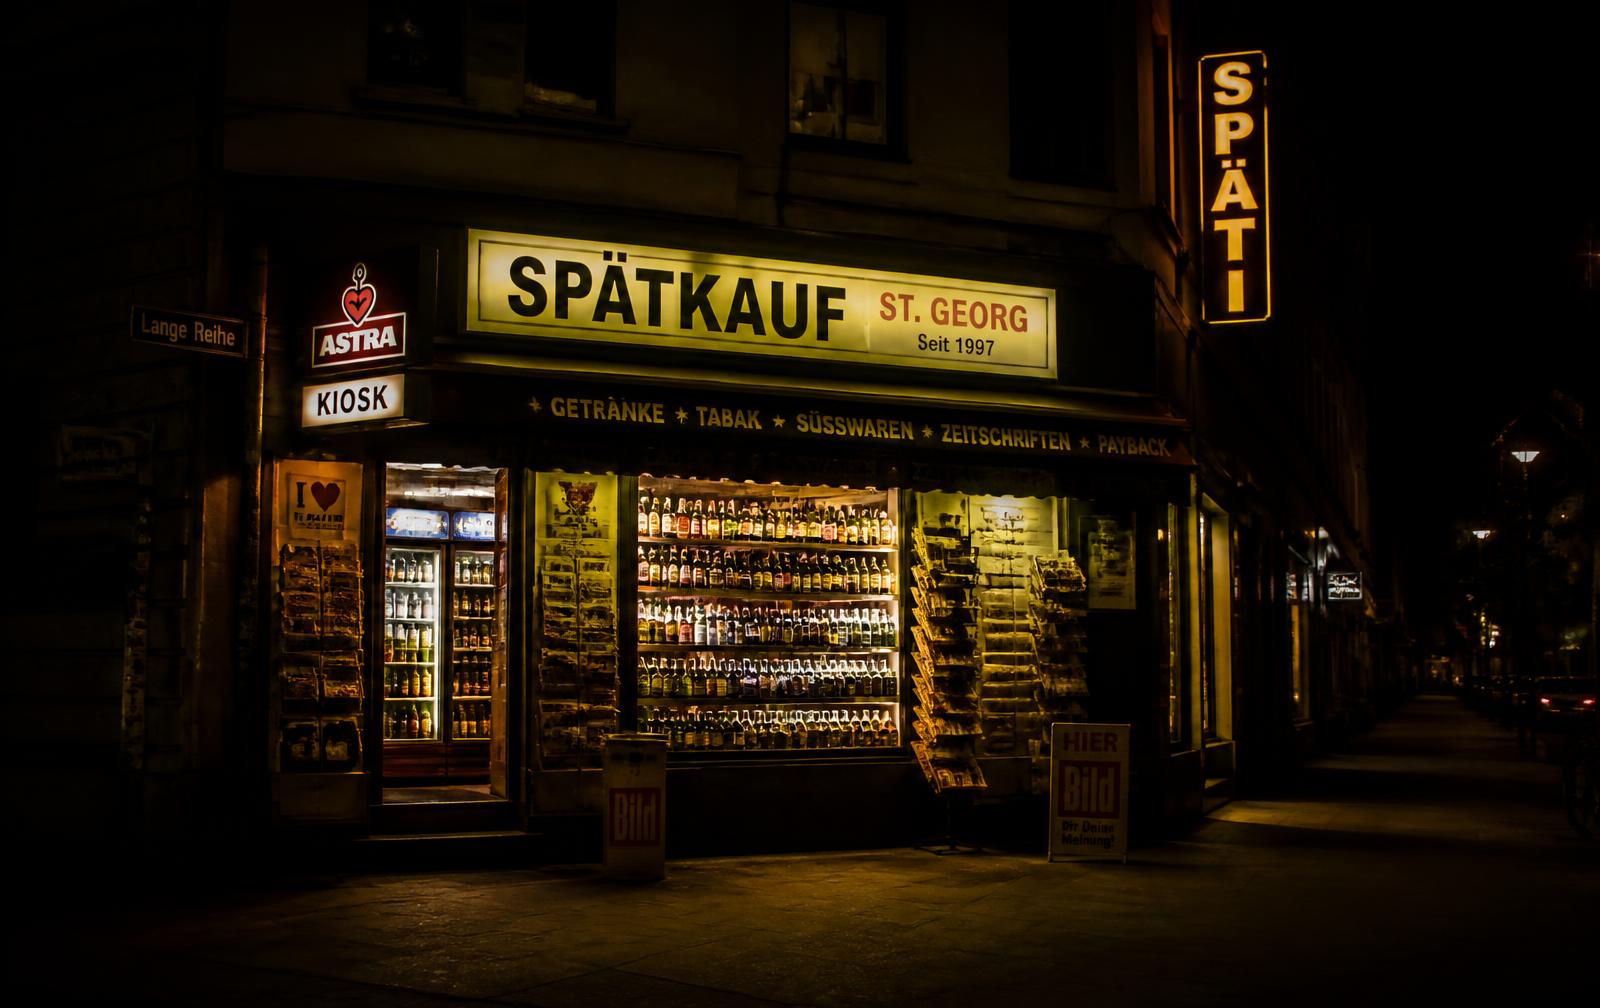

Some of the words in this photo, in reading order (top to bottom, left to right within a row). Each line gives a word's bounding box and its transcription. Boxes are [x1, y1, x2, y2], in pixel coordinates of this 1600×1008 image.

[1210, 61, 1259, 312] SPÄTI
[507, 250, 847, 342] SPÄTKAUF
[879, 292, 922, 324] ST.
[930, 296, 1029, 333] GEORG
[141, 311, 188, 342] Lange
[194, 321, 236, 347] Reihe
[319, 324, 397, 356] ASTRA
[917, 333, 950, 354] Seit
[955, 336, 995, 357] 1997
[316, 384, 389, 416] KIOSK
[550, 395, 666, 425] GETRÄNKE
[695, 405, 762, 430] TABAK
[795, 410, 915, 441] SÜSSWAREN
[940, 423, 1072, 451] ZEITSCHRIFTEN
[1097, 434, 1171, 457] PAYBACK
[1063, 731, 1118, 753] HIER
[1063, 765, 1115, 813] Bild
[613, 792, 657, 841] Bild
